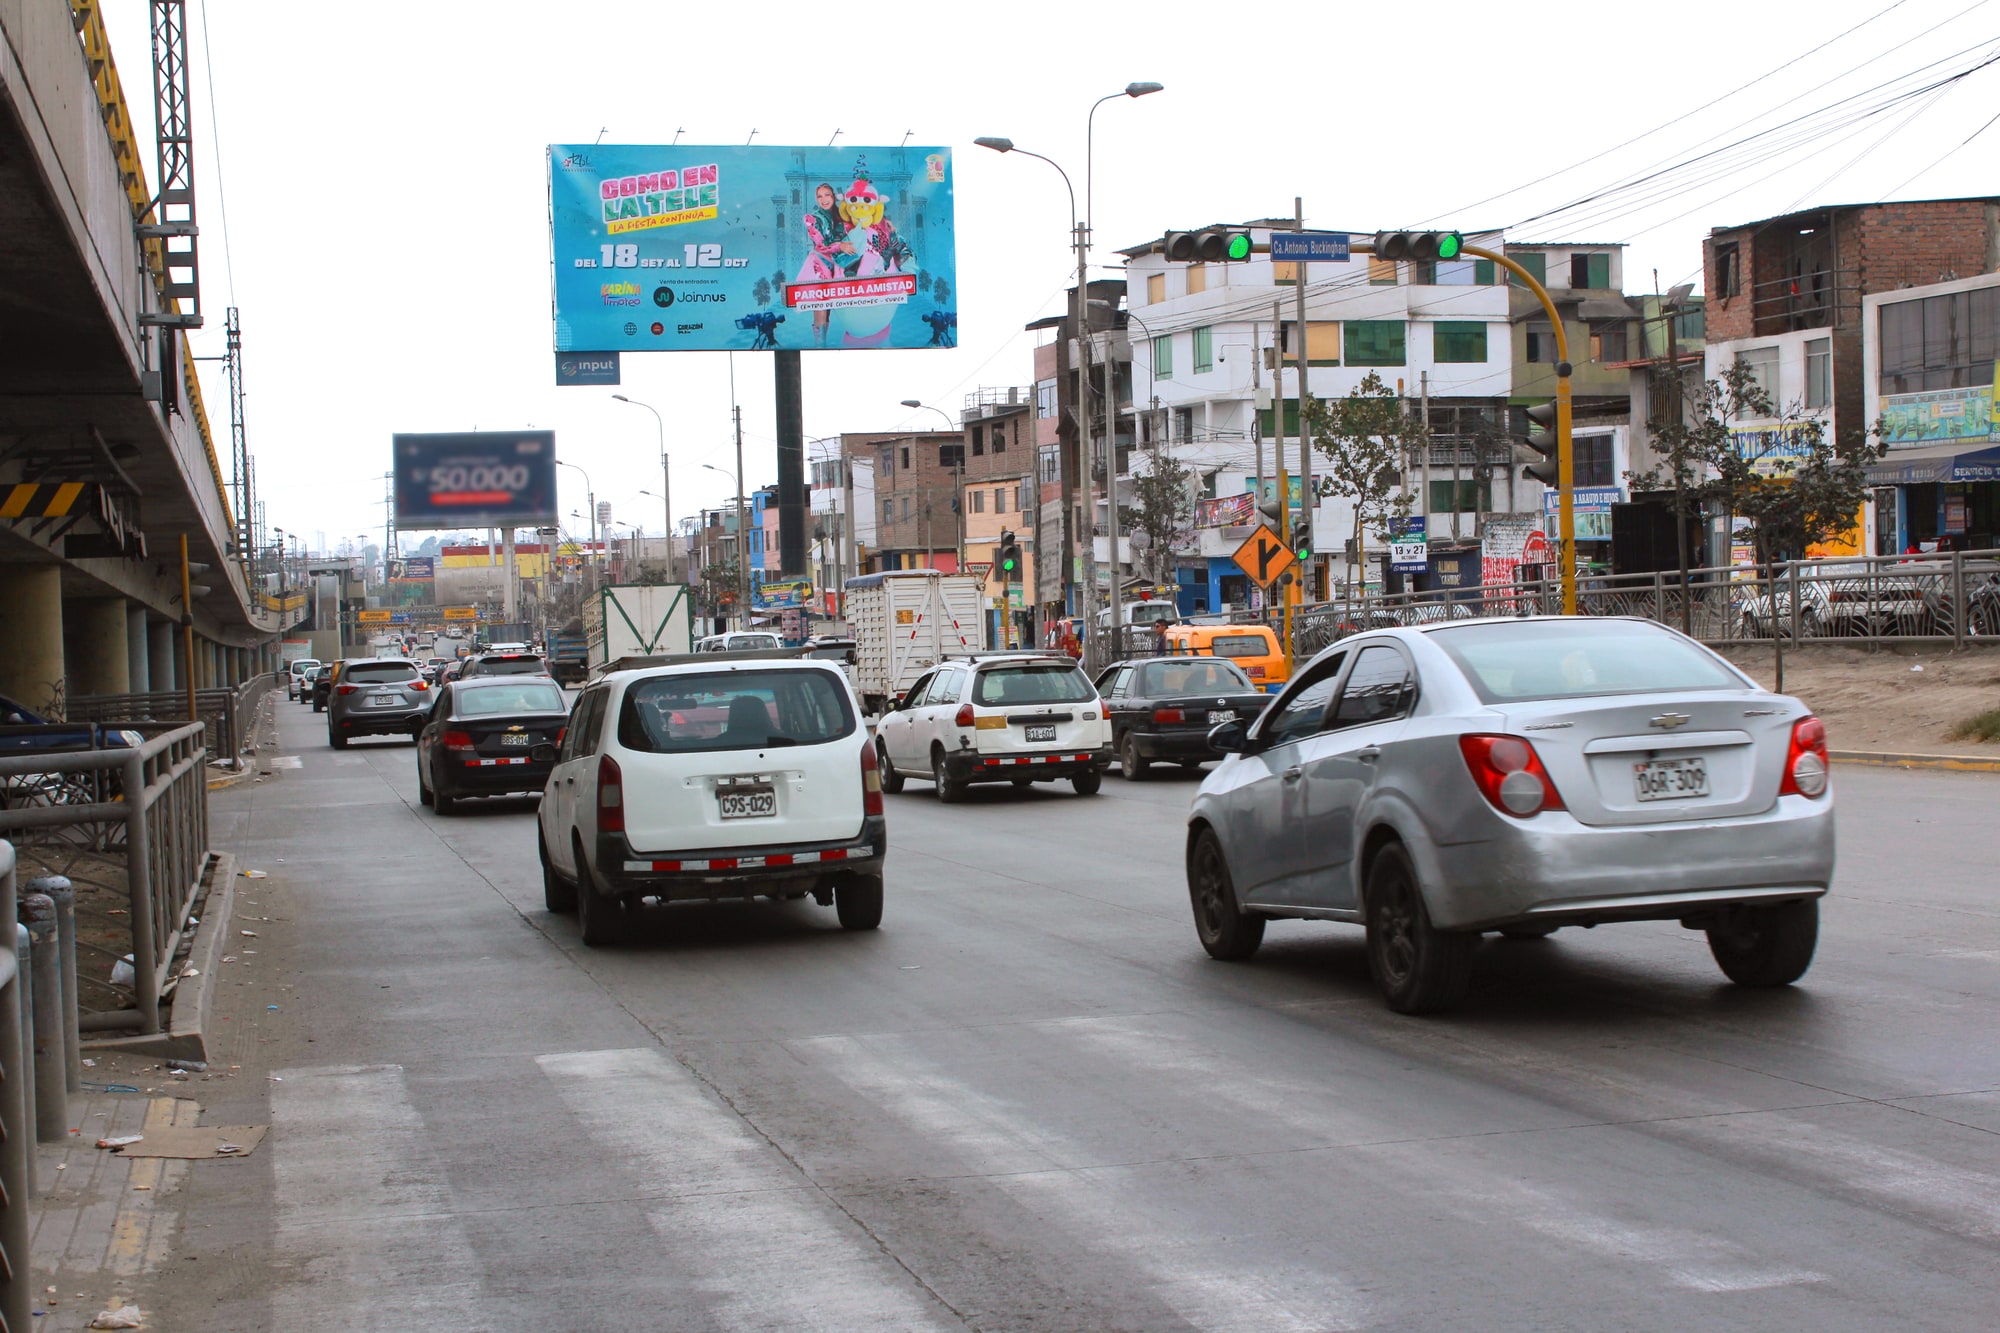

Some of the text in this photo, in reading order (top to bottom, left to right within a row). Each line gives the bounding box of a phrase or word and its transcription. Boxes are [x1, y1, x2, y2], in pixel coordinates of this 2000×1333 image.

[602, 165, 717, 200] COMO EN
[604, 184, 717, 221] LA TELE
[613, 223, 625, 233] LA
[627, 219, 657, 231] FIESTA
[574, 244, 748, 268] DEL 18 SET AL 12 OCT
[1273, 241, 1347, 257] Ca. Antonio Buckingham
[601, 281, 641, 295] KARINA
[794, 281, 913, 300] PARQUE DE LA AMISTAD
[602, 293, 641, 307] Timoteo
[677, 292, 727, 303] Joinnus
[799, 301, 824, 310] CENTRO
[579, 360, 614, 371] input
[1954, 466, 1993, 477] SERVICIO
[1578, 492, 1599, 506] ARAUJO
[1604, 491, 1619, 506] HIJOS
[1395, 545, 1404, 555] 13
[1413, 545, 1424, 555] 27
[722, 796, 773, 813] C9S-029
